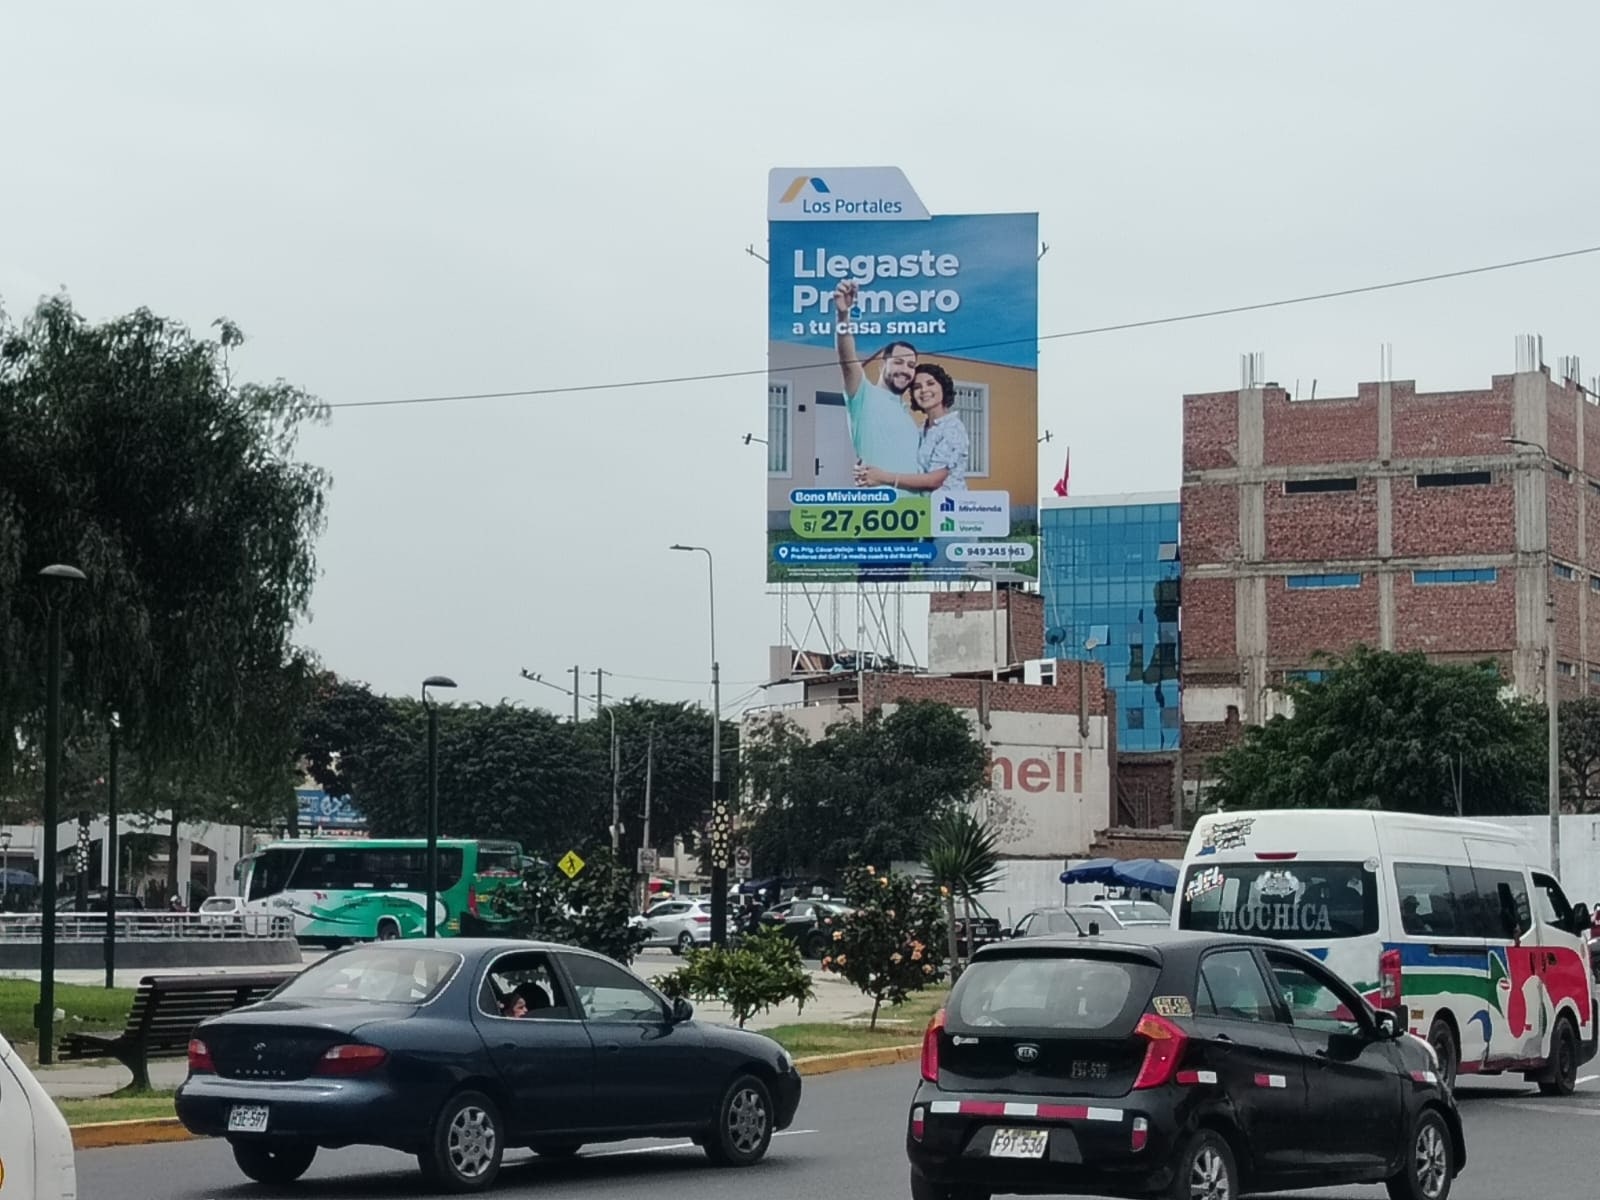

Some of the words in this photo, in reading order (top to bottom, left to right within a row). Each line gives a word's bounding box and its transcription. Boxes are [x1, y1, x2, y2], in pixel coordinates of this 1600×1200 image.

[802, 199, 830, 214] Los
[835, 198, 902, 214] Portales
[793, 248, 959, 285] Llegaste
[792, 285, 960, 313] Prmero
[792, 322, 804, 334] a
[810, 320, 830, 334] tu
[836, 321, 881, 334] casa
[886, 318, 946, 334] smart
[795, 491, 825, 502] Bono
[827, 491, 889, 502] Mivivienda
[959, 504, 1002, 513] Mivivienda
[803, 521, 817, 533] S/
[967, 547, 986, 556] 949
[988, 547, 1006, 556] 345
[1008, 547, 1026, 556] 961
[1217, 903, 1333, 932] MOCHICA
[1018, 1048, 1036, 1058] KIA
[991, 1135, 1045, 1154] F9T-536
